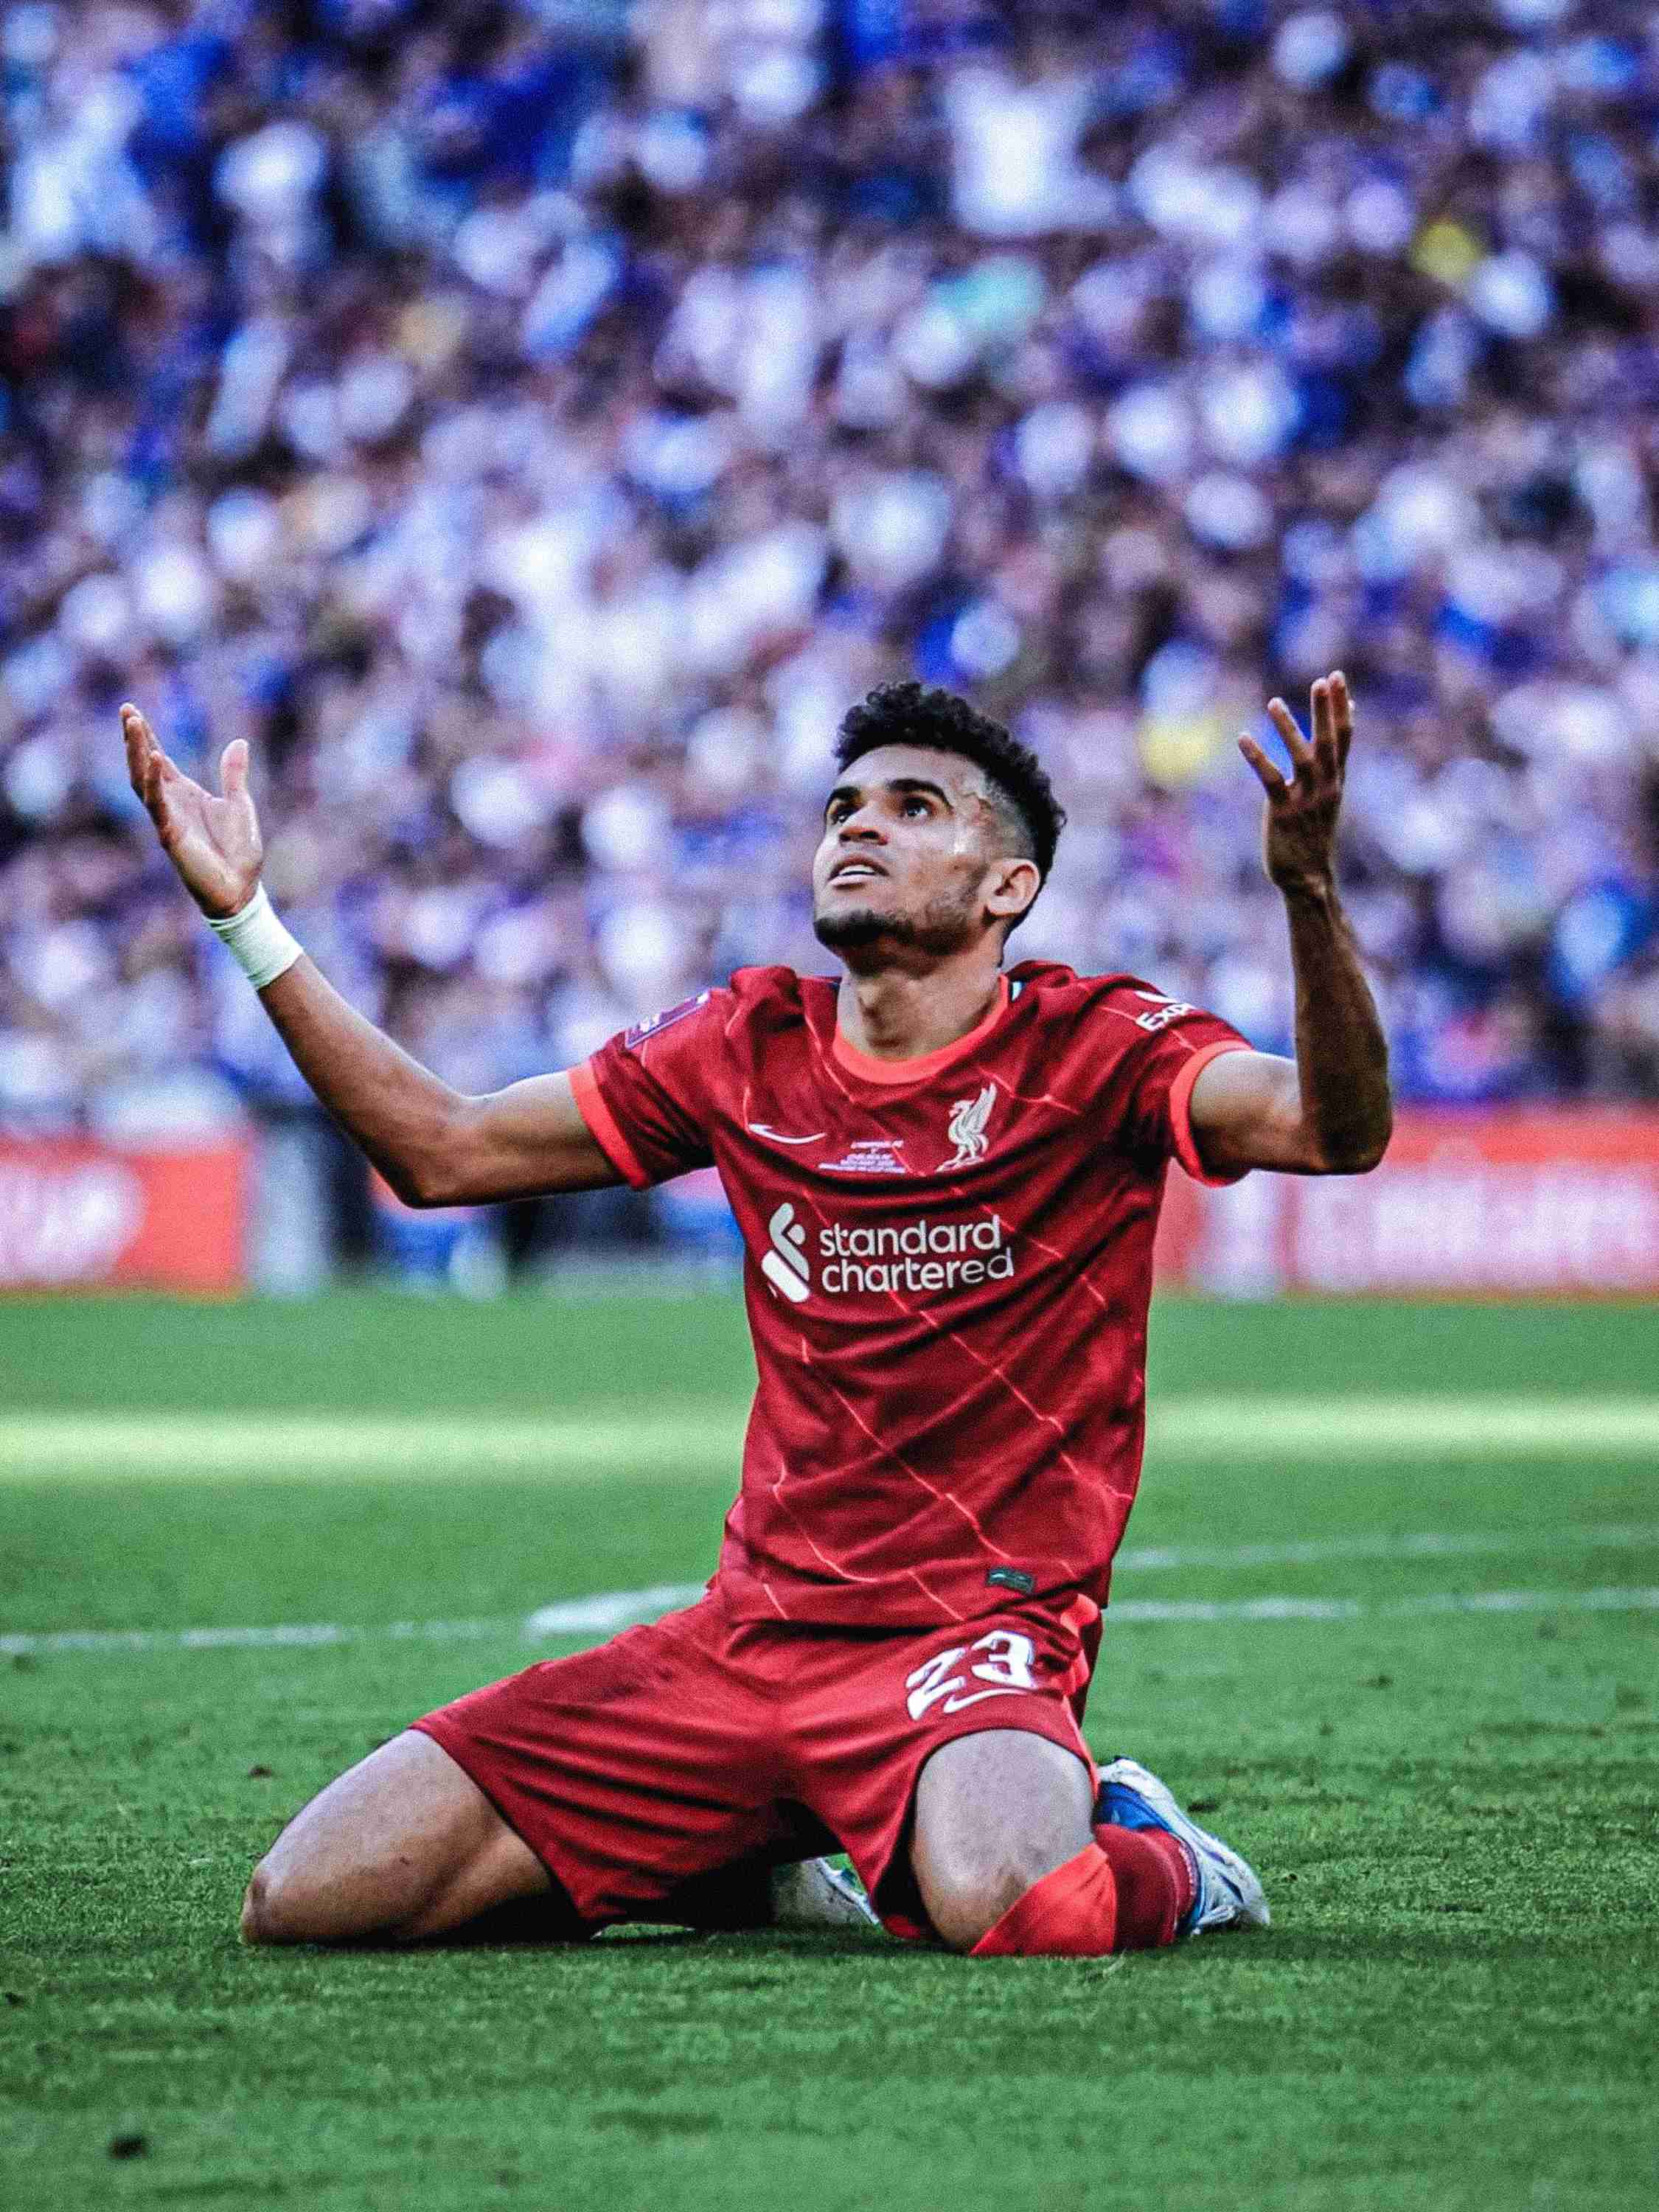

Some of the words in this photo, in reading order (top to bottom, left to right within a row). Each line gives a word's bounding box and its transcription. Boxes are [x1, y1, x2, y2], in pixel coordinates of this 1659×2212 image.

[819, 1214, 1001, 1256] standard
[822, 1247, 1014, 1293] chartered
[905, 1630, 1037, 1721] 23
